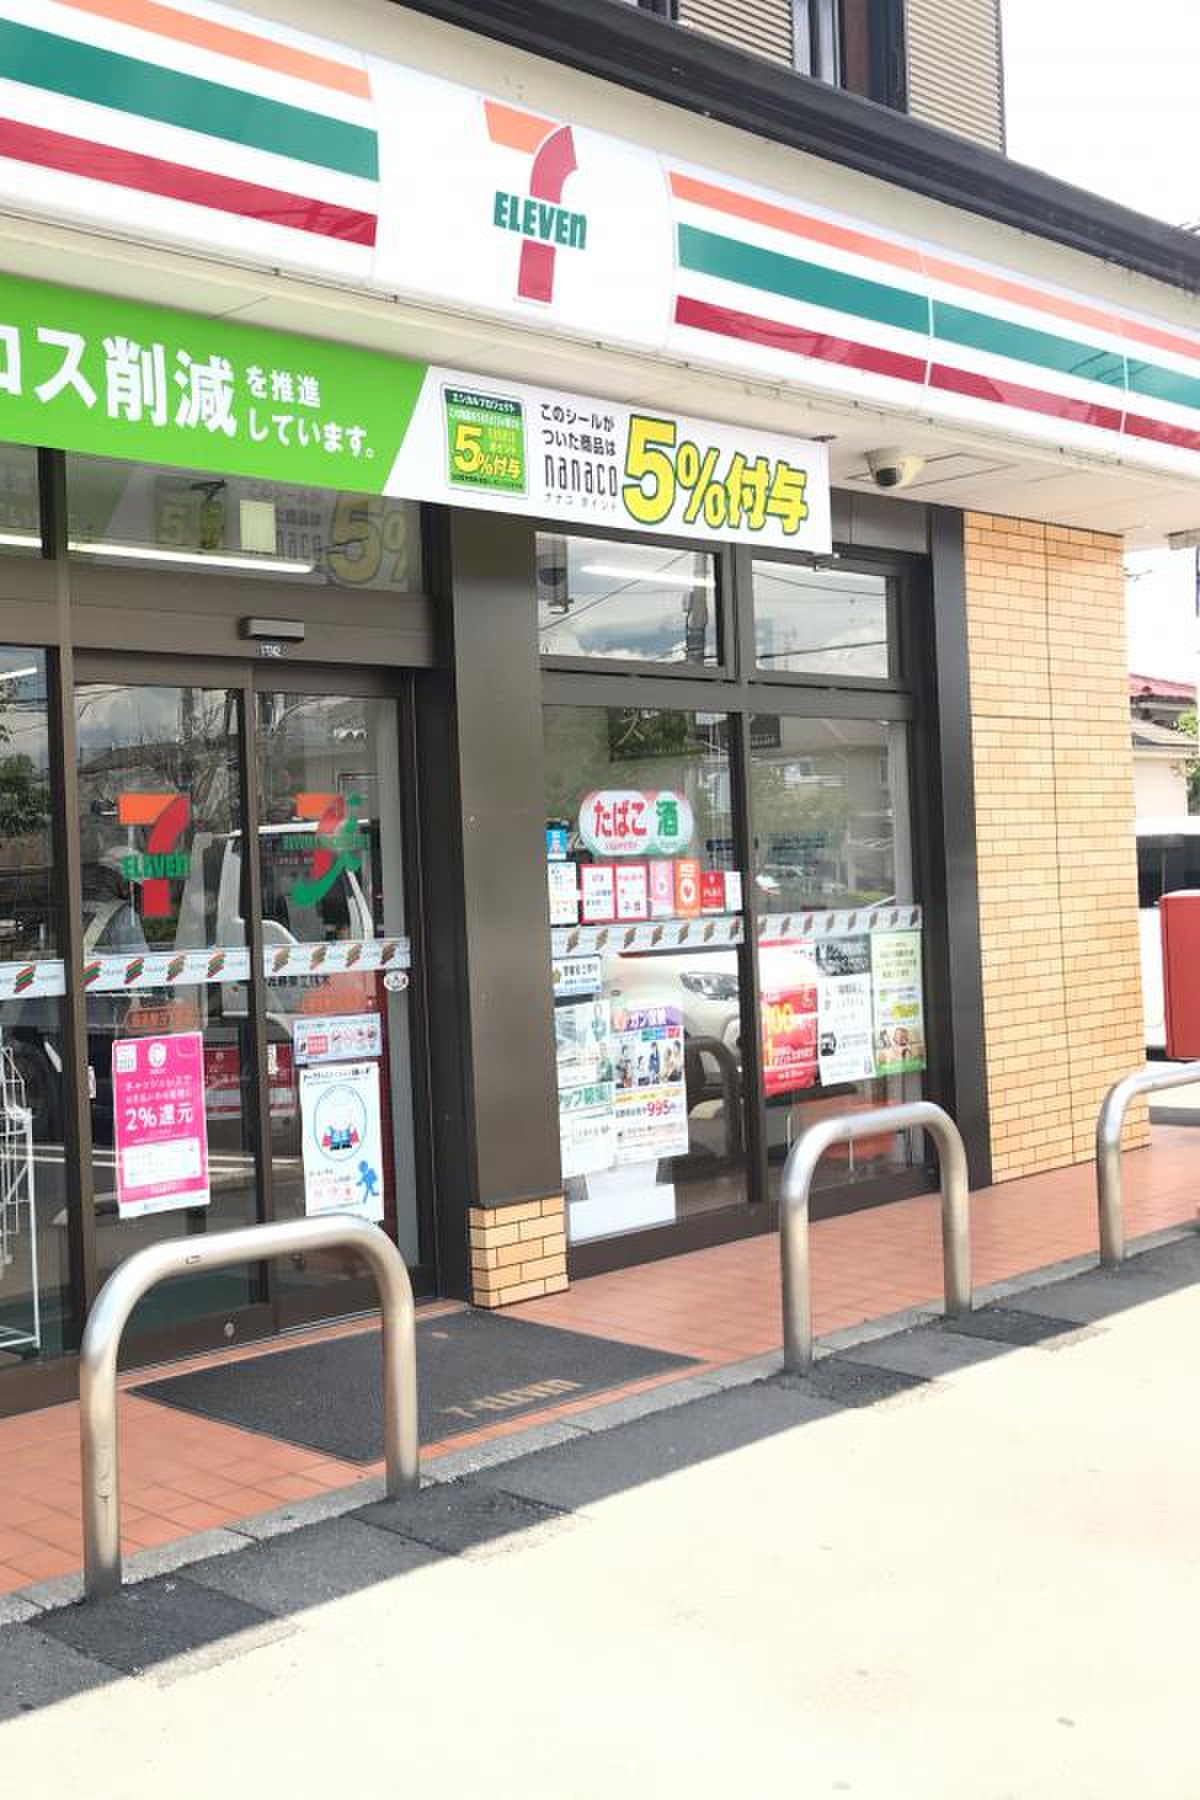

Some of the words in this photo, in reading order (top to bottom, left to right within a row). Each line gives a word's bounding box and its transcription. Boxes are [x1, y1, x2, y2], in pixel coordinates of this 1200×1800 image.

[246, 365, 321, 408] を推進
[250, 408, 374, 459] しています。
[540, 402, 615, 433] このシールが
[542, 428, 617, 457] ついた商品は
[544, 454, 618, 498] nanaco
[622, 414, 808, 535] 5%付与
[593, 801, 647, 837] たばこ
[656, 801, 679, 836] 酒
[125, 1103, 193, 1131] 2%還元
